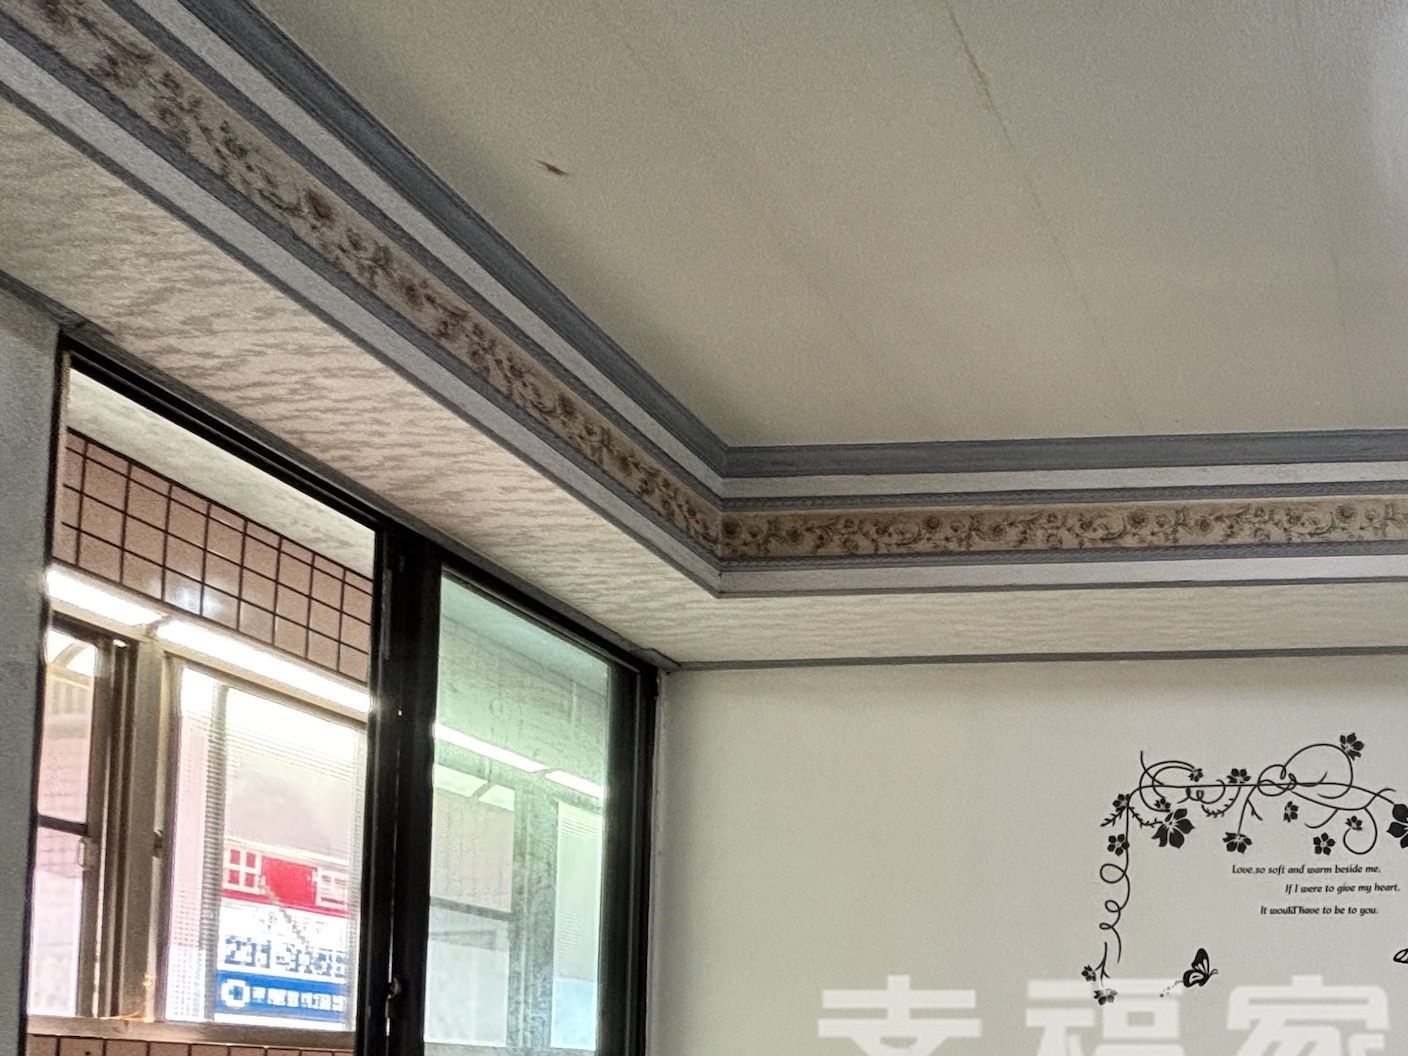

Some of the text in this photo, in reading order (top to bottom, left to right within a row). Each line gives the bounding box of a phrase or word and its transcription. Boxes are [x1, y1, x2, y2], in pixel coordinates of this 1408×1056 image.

[1268, 864, 1285, 876] soft
[1287, 864, 1305, 874] and
[1307, 866, 1332, 874] warm
[1335, 864, 1362, 874] beside
[1285, 884, 1294, 895] If
[1337, 882, 1355, 894] give
[1358, 885, 1372, 894] my
[1260, 905, 1267, 915] It
[1269, 905, 1297, 915] would
[1297, 905, 1319, 915] have
[1322, 906, 1332, 915] to
[1334, 905, 1345, 915] be
[1347, 906, 1357, 914] to
